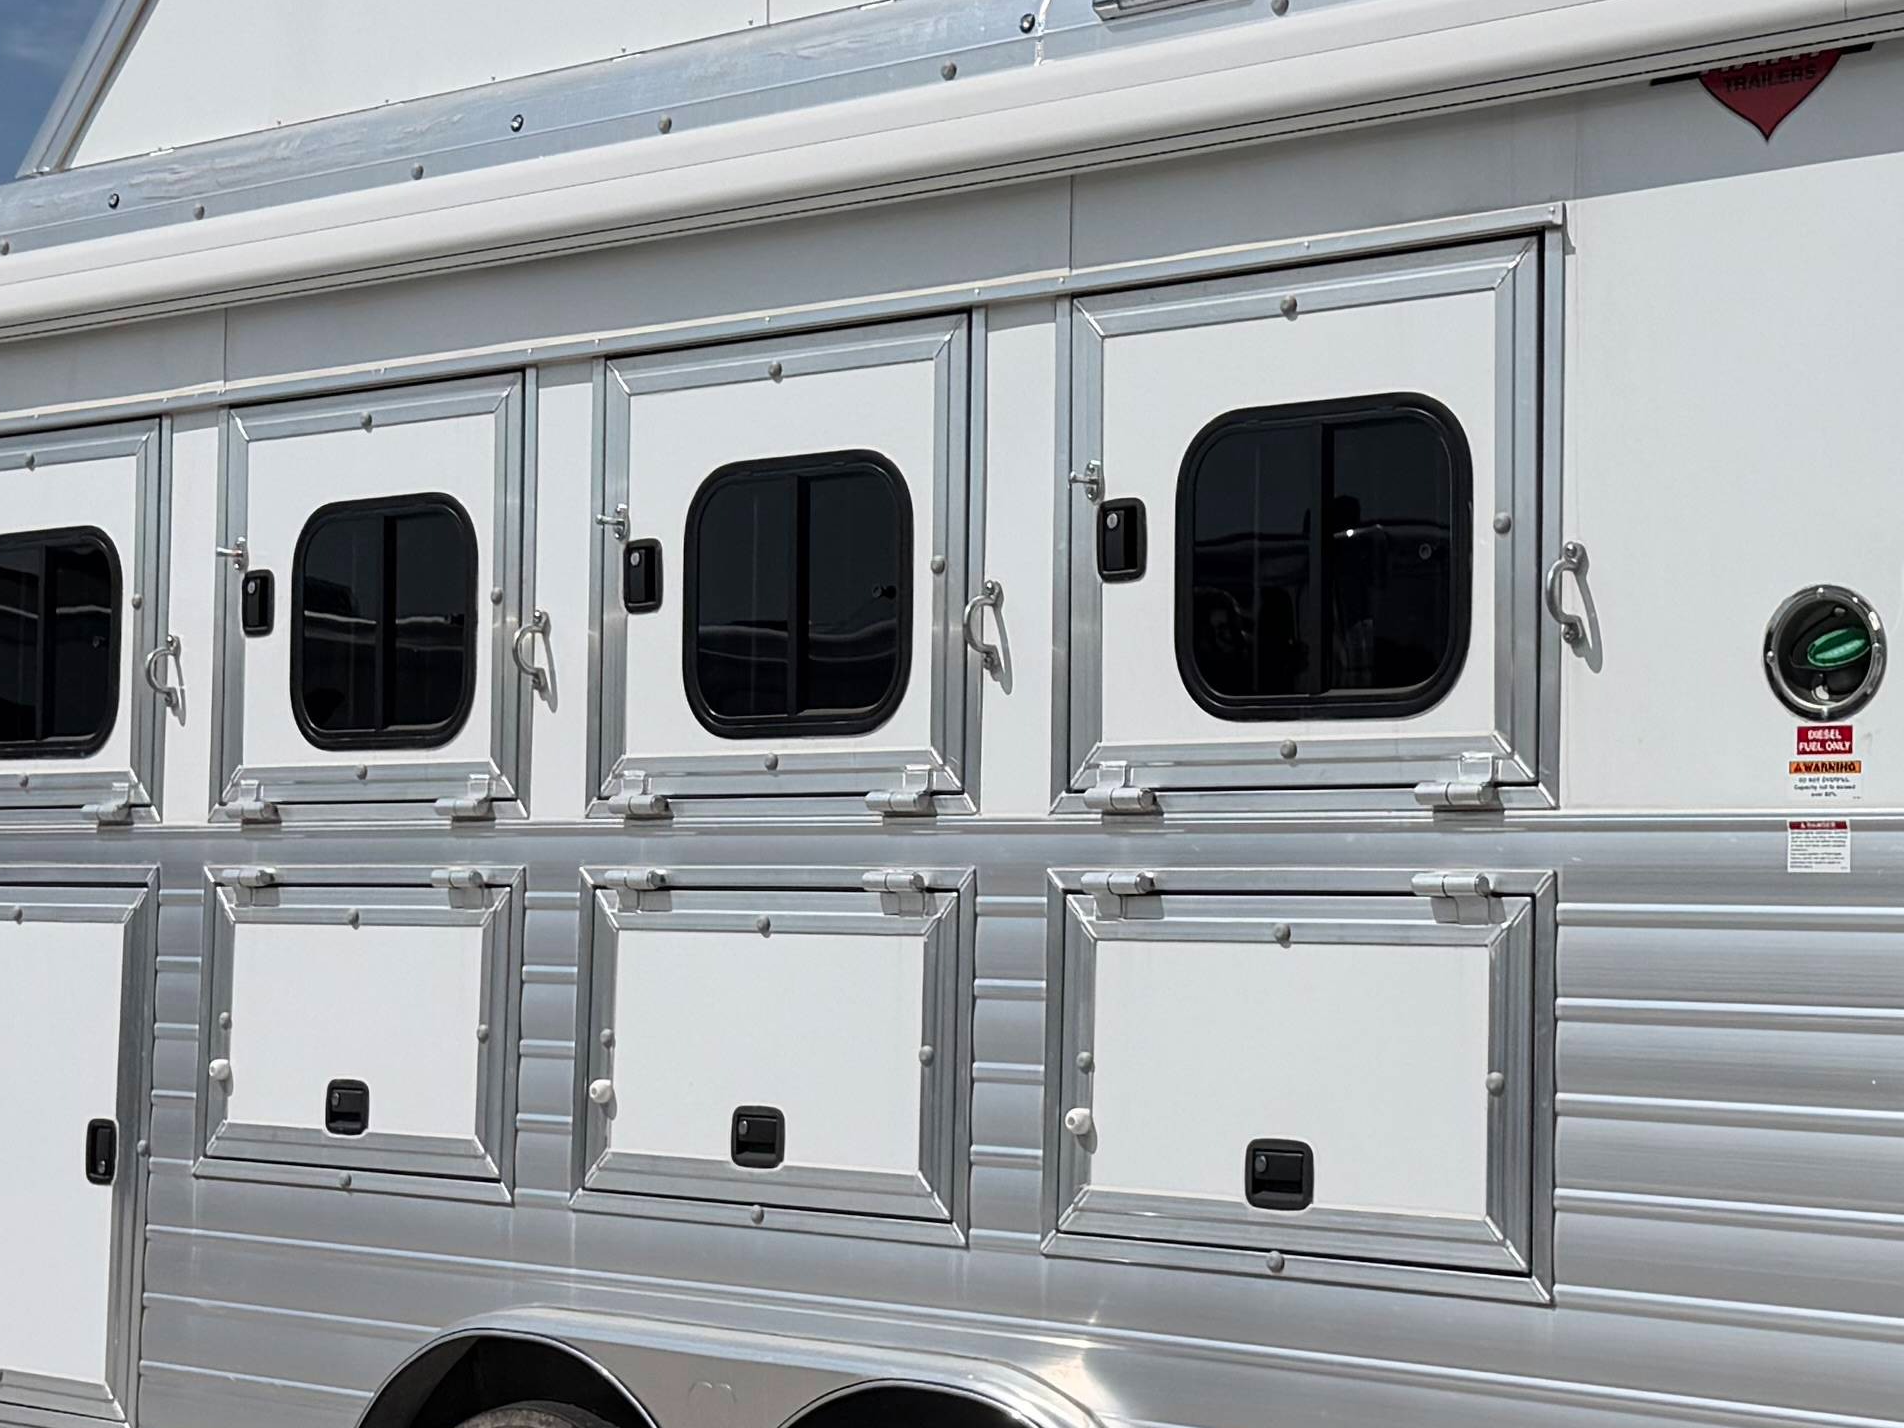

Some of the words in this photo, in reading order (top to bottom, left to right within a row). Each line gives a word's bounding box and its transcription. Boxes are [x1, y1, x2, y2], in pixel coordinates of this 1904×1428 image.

[1722, 63, 1818, 93] TRAILERS
[1807, 728, 1842, 740] DIESEL
[1799, 741, 1824, 752] FUEL
[1825, 741, 1851, 752] ONLY
[1803, 762, 1856, 773] WARNING
